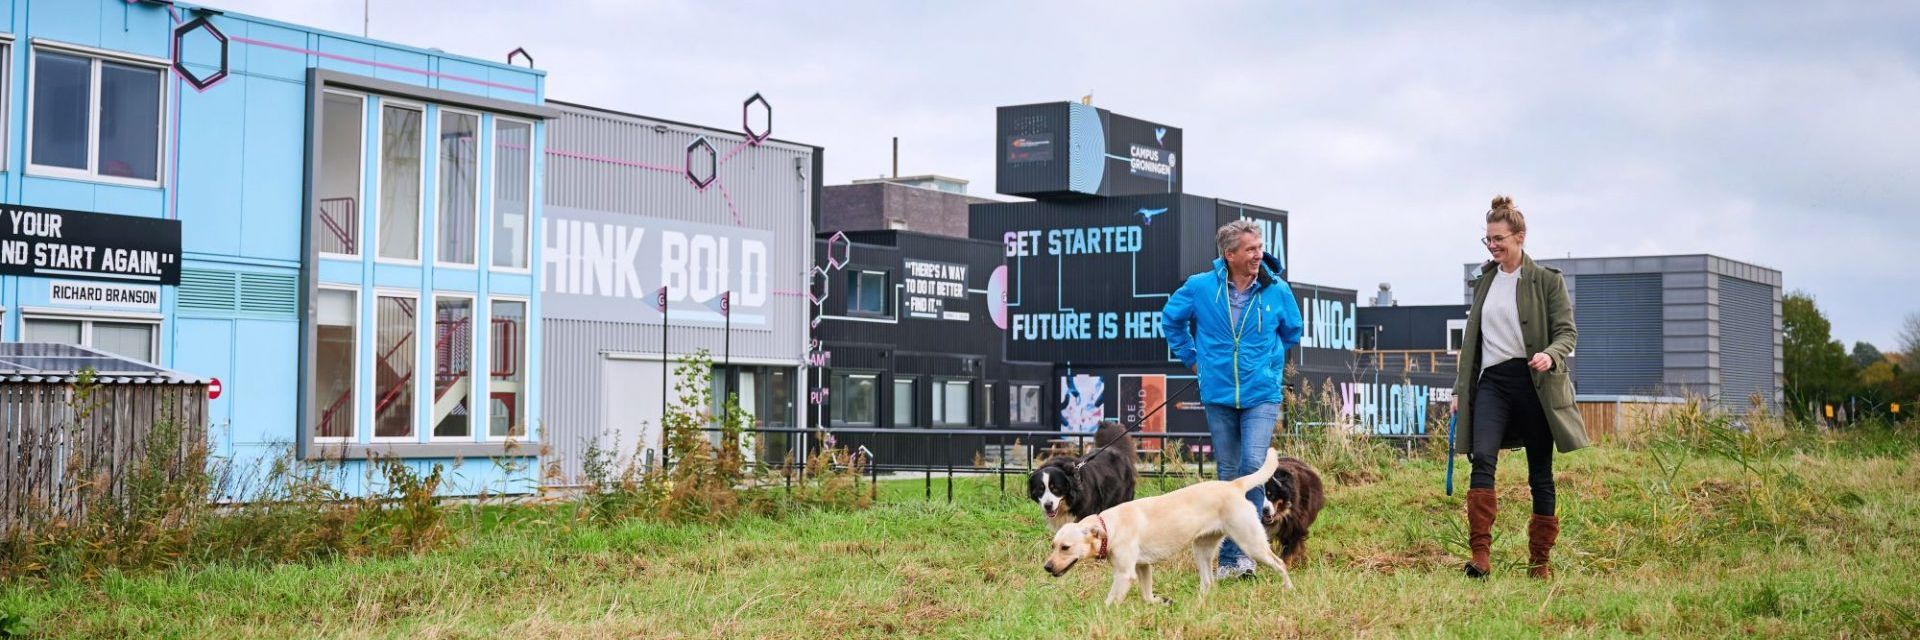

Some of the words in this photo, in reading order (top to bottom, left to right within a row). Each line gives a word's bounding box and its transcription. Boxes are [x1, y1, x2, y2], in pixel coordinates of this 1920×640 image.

[1130, 145, 1159, 161] CAMPUS
[1130, 158, 1171, 175] GRONINGEN
[10, 210, 62, 238] YOUR
[1003, 229, 1042, 257] GET
[1048, 225, 1143, 255] STARTED
[34, 242, 96, 270] START
[660, 229, 767, 307] BOLD
[941, 264, 947, 279] A
[948, 265, 965, 281] WAY
[52, 285, 102, 302] RICHARD
[105, 288, 157, 304] BRANSON
[905, 278, 916, 294] TO
[916, 279, 927, 295] DO
[928, 280, 936, 296] IT
[936, 281, 963, 298] BETTER
[910, 296, 927, 312] FIND
[1012, 312, 1092, 341] FUTURE
[1099, 312, 1119, 340] IS
[1300, 297, 1356, 351] POINT
[1340, 382, 1428, 435] ANOTHER
